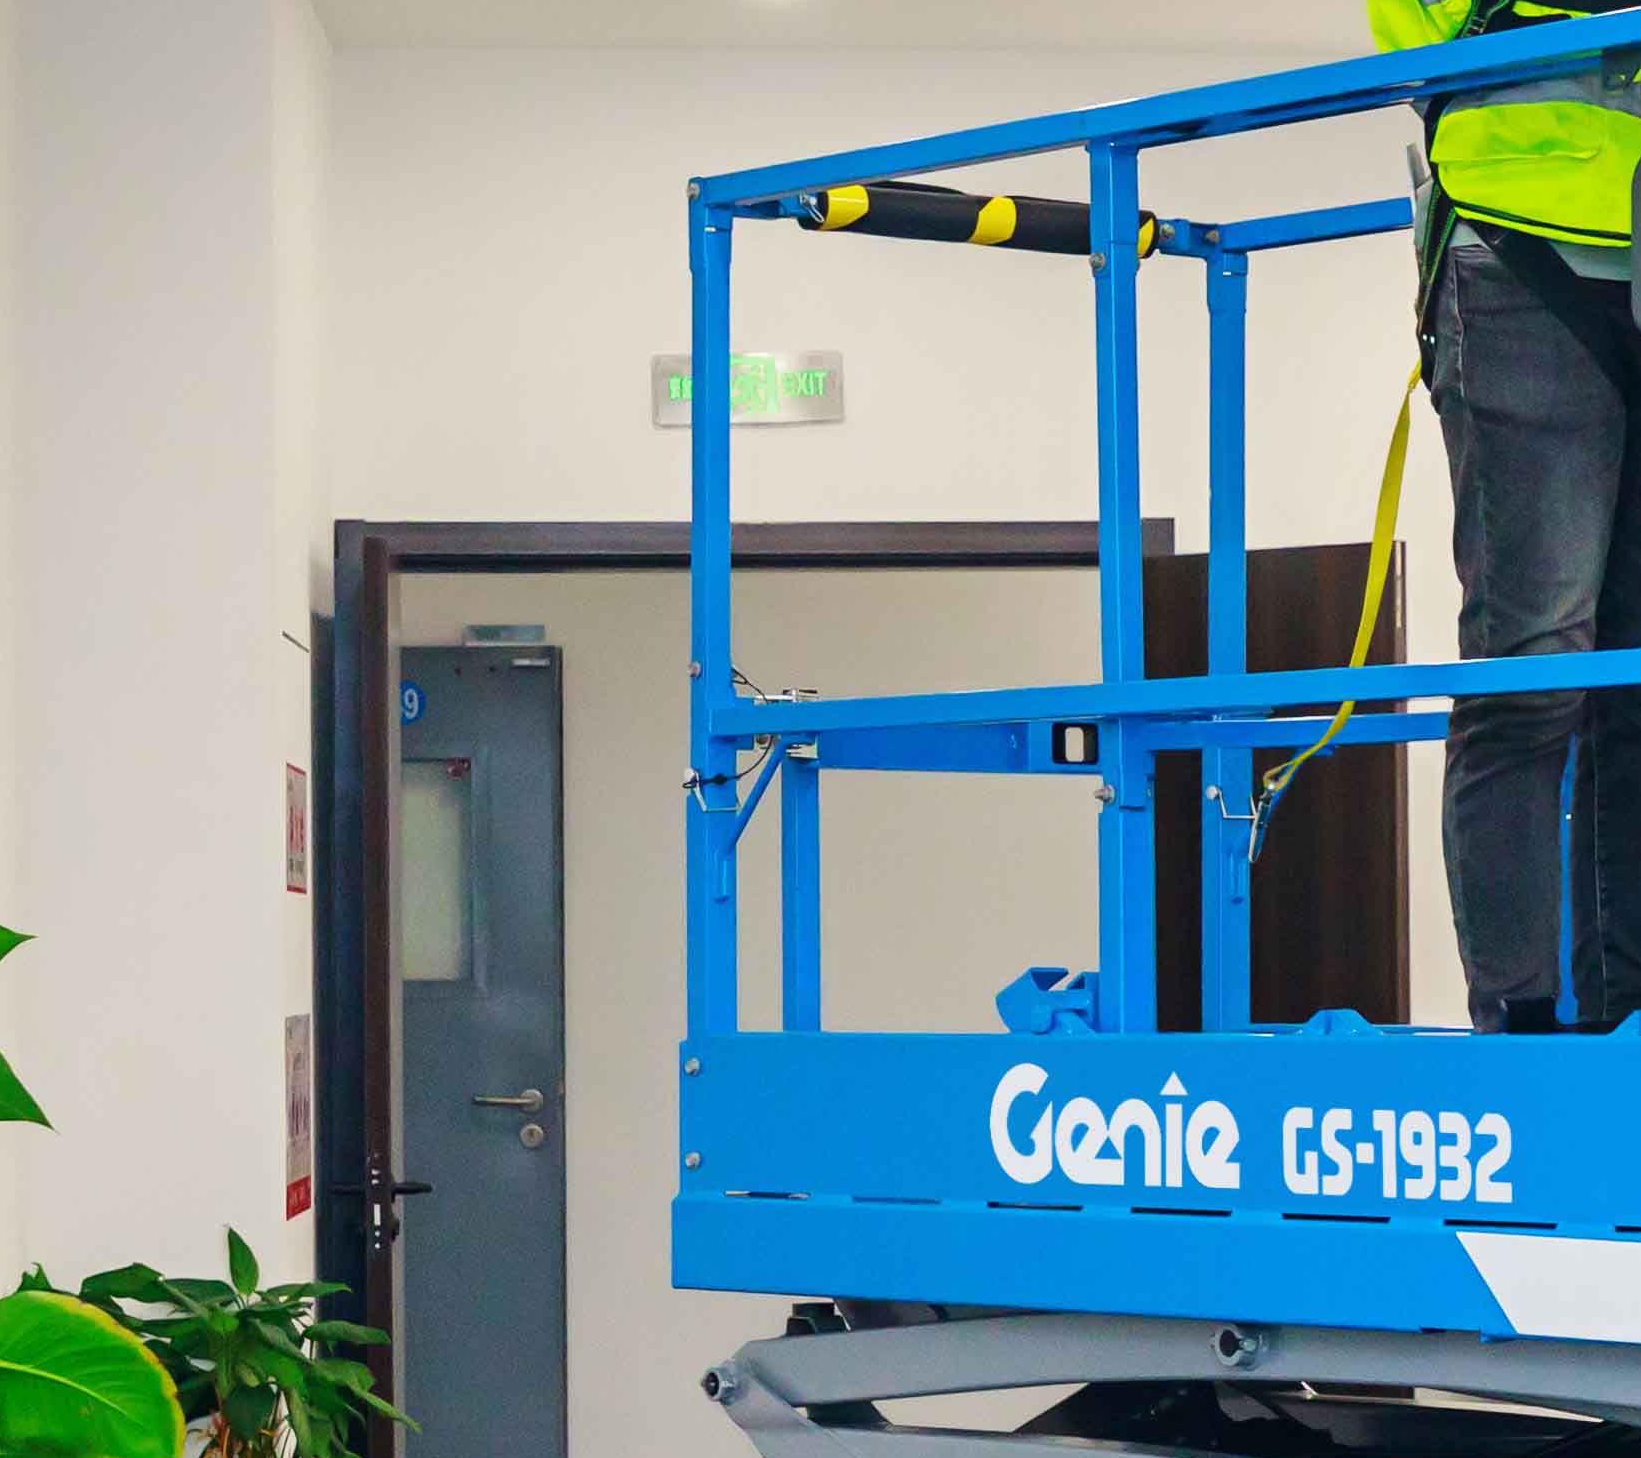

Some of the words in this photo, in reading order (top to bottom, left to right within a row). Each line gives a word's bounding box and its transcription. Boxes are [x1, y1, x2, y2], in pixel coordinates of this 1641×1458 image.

[782, 371, 827, 398] EXIT
[990, 1063, 1240, 1189] Genie
[1282, 1107, 1513, 1203] GS-1932
